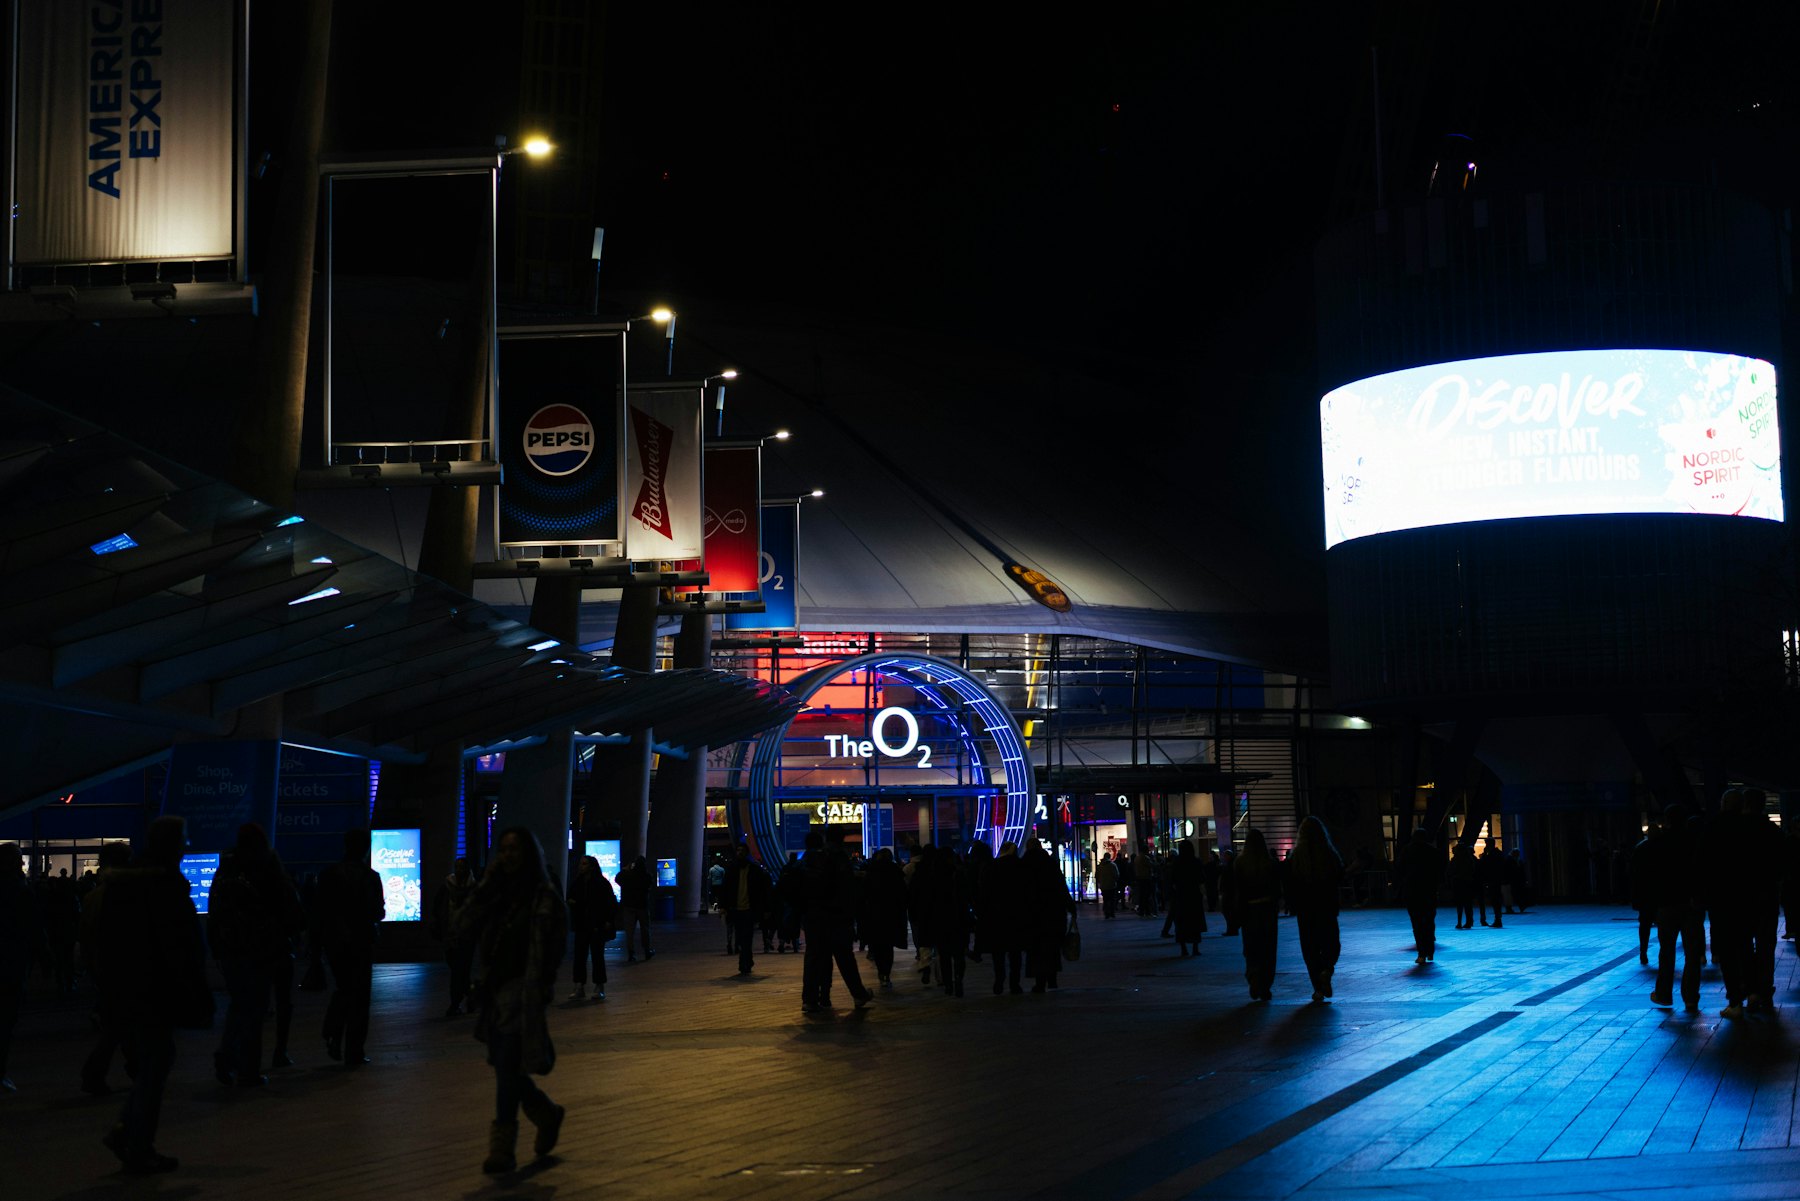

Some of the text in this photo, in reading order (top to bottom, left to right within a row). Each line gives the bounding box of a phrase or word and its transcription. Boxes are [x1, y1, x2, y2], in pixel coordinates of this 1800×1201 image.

[527, 431, 591, 448] PEPSI
[1508, 426, 1604, 458] INSTANT,
[1534, 453, 1642, 484] FLAVOURS
[1682, 447, 1745, 469] NORDIC
[641, 418, 662, 532] Budweiser
[1692, 465, 1742, 486] SPIRIT
[823, 706, 932, 769] The O2
[197, 764, 234, 779] Shop,
[183, 780, 248, 797] Dine, Play
[1117, 795, 1130, 808] O2
